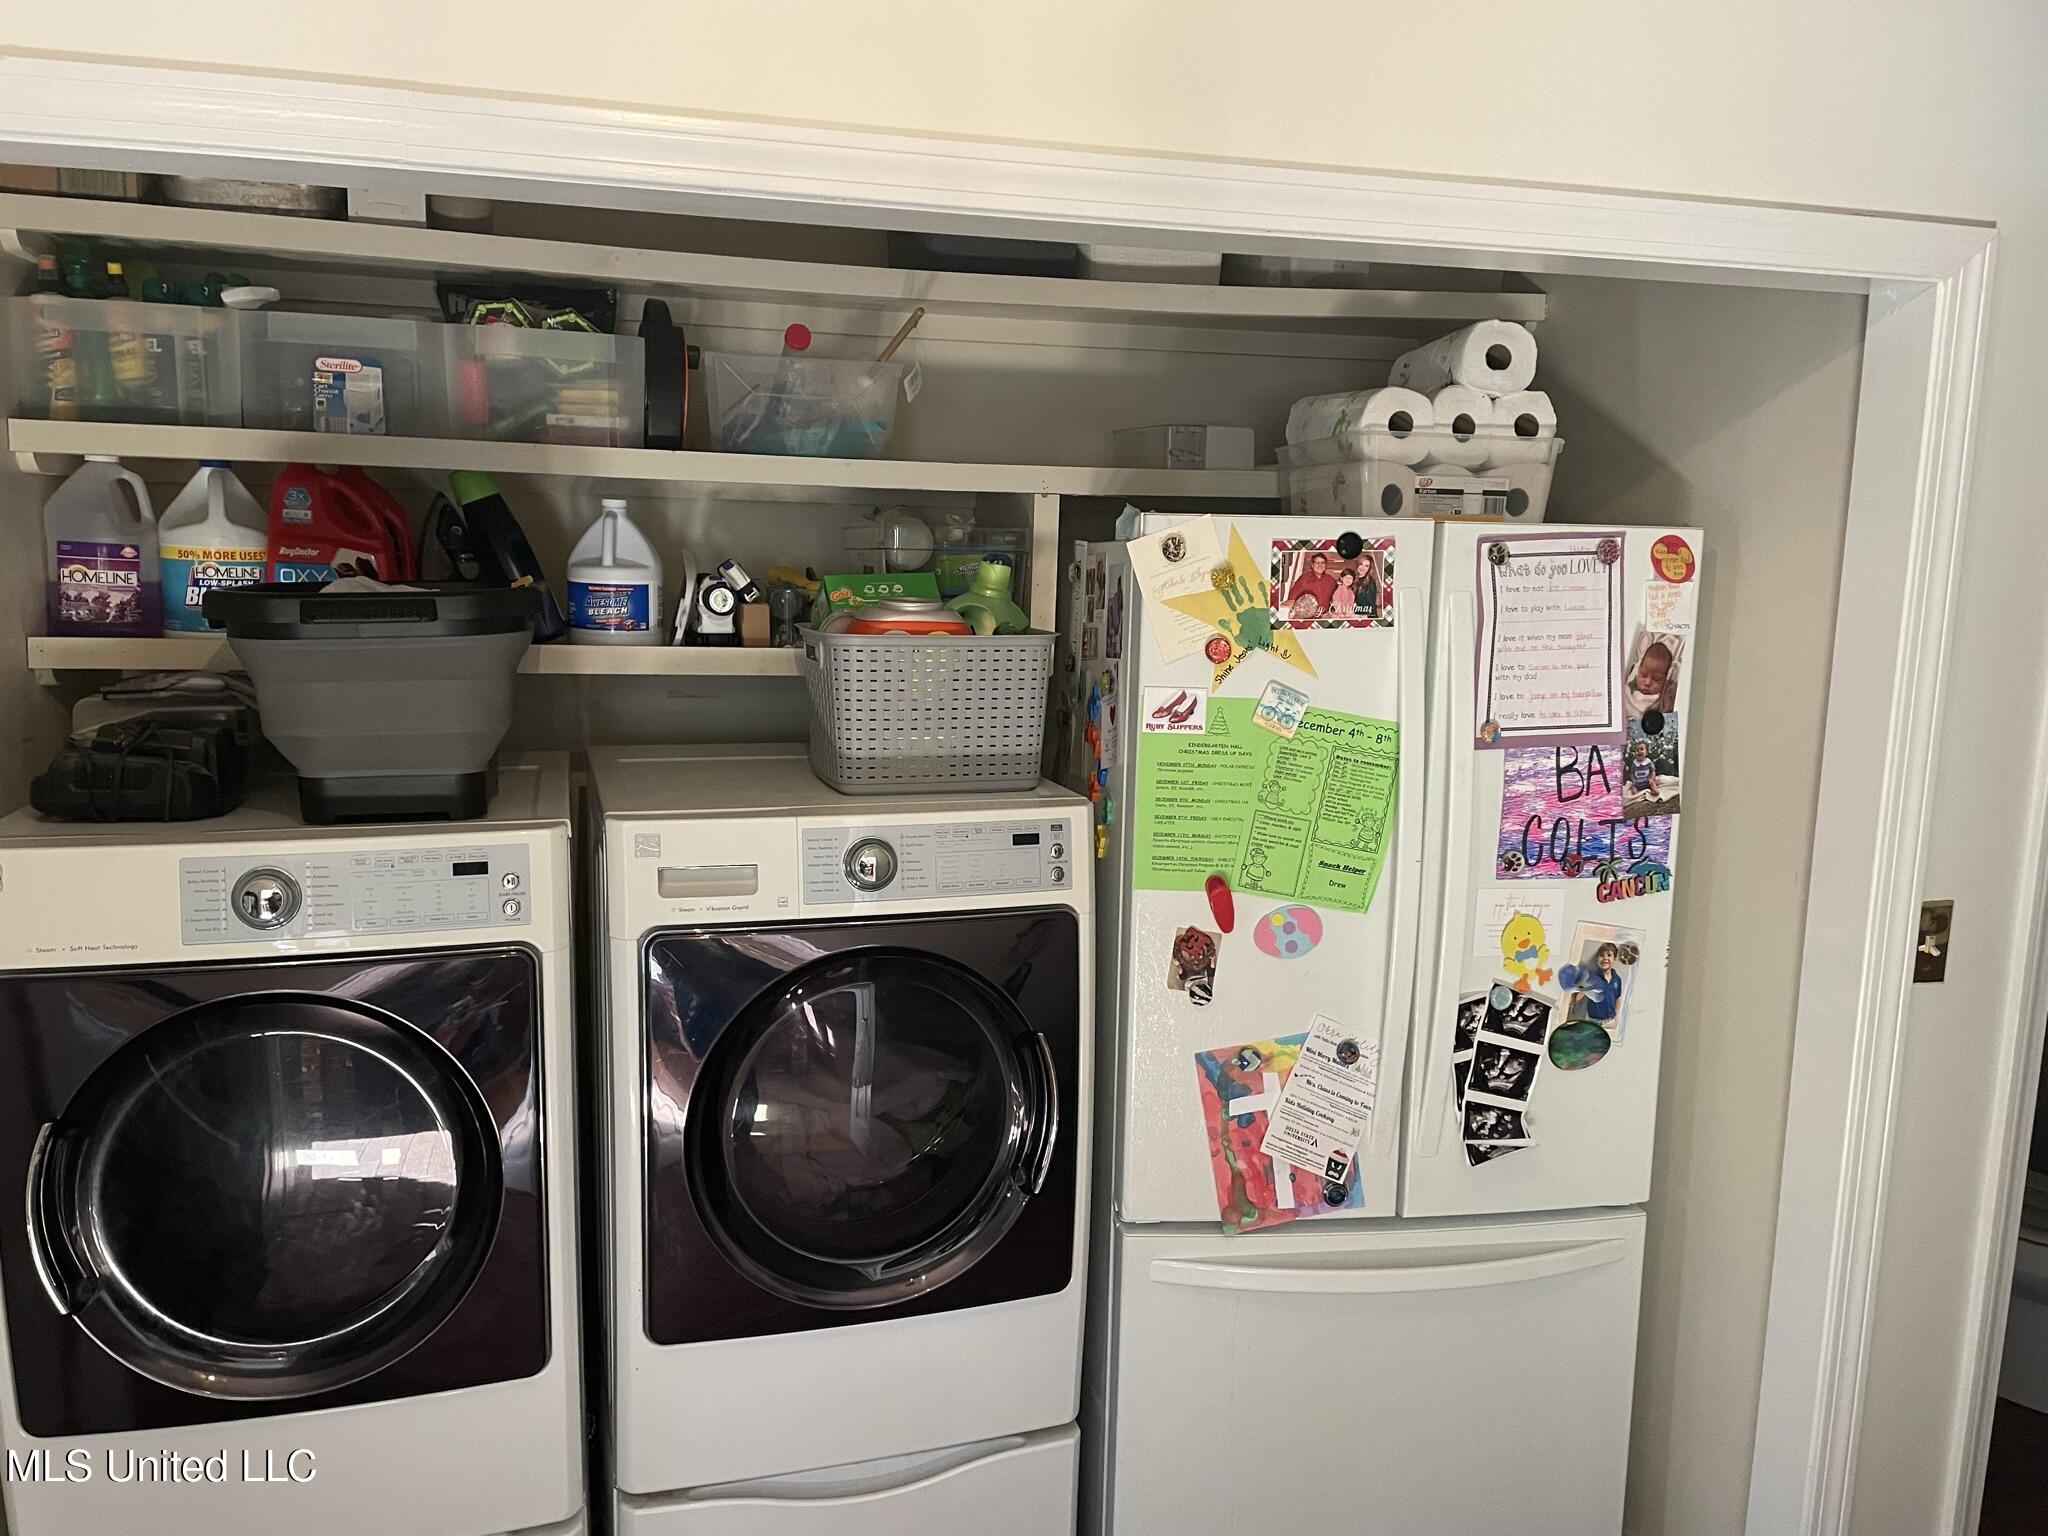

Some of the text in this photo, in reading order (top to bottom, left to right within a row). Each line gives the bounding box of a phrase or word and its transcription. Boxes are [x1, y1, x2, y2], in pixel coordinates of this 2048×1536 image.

[320, 359, 358, 371] Sterilite
[177, 549, 200, 560] 50%
[202, 550, 237, 561] MORE
[195, 566, 260, 579] HOMELINE
[280, 568, 328, 583] OXY
[1534, 561, 1546, 577] do
[1548, 562, 1568, 579] you
[60, 569, 137, 586] HOMELINE
[199, 579, 254, 588] LOW-SPLASH
[831, 589, 852, 601] Gain
[587, 607, 629, 616] BLEACH
[1505, 605, 1519, 613] love
[1530, 605, 1544, 613] play
[1547, 604, 1561, 612] with
[1215, 664, 1234, 684] Shine
[1258, 636, 1279, 653] Light
[1512, 674, 1522, 682] my
[1524, 673, 1538, 681] dad
[1498, 712, 1519, 720] really
[1521, 711, 1535, 719] love
[1145, 723, 1203, 731] RUBY SLIPPERS
[1298, 720, 1345, 737] ecember
[1348, 727, 1364, 739] 4th
[1375, 734, 1392, 745] 8th
[1556, 745, 1612, 804] BA
[1318, 860, 1367, 876] Snack Helper
[1328, 880, 1347, 889] Drew
[1283, 1130, 1311, 1145] UNIVERSITY
[1284, 1125, 1314, 1141] DELTA STATE
